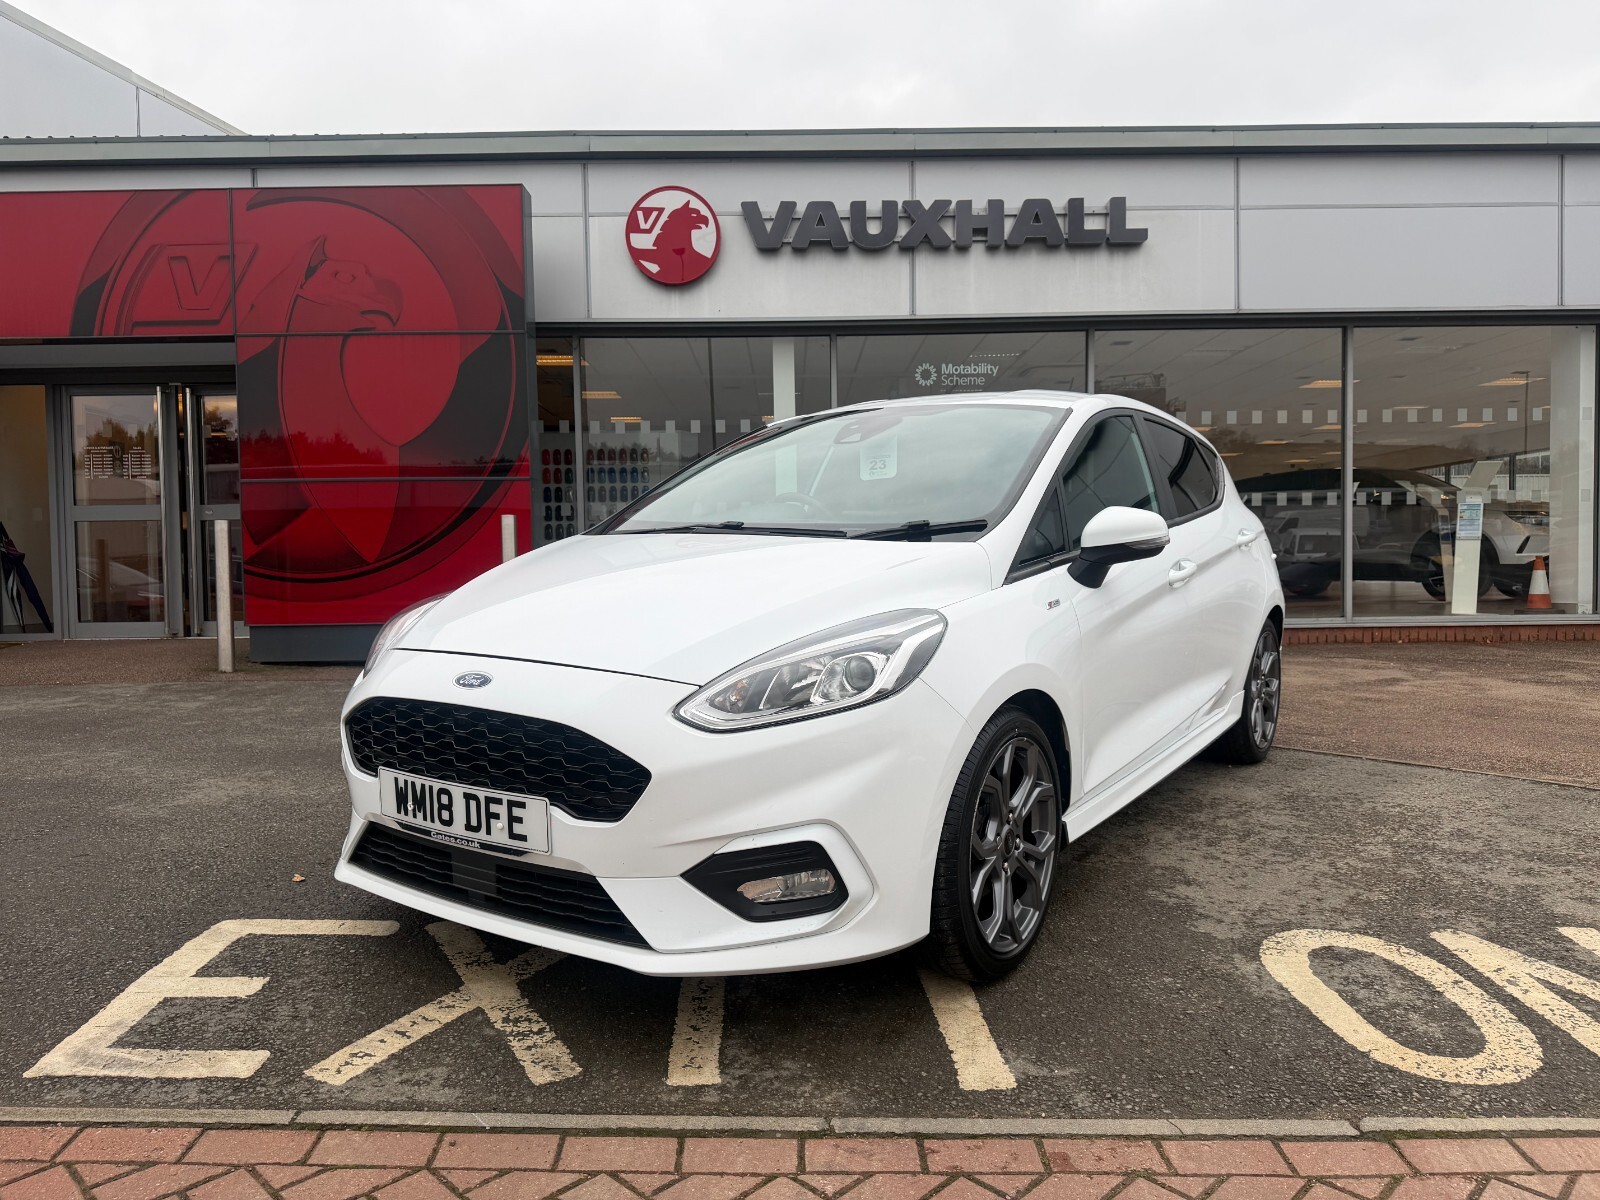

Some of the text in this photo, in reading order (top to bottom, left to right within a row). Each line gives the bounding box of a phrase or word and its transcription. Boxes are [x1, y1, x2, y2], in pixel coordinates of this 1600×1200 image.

[740, 196, 1149, 251] VAUXHALL
[941, 363, 999, 377] Motability
[941, 374, 986, 386] Scheme
[394, 776, 529, 843] WM18 DFE
